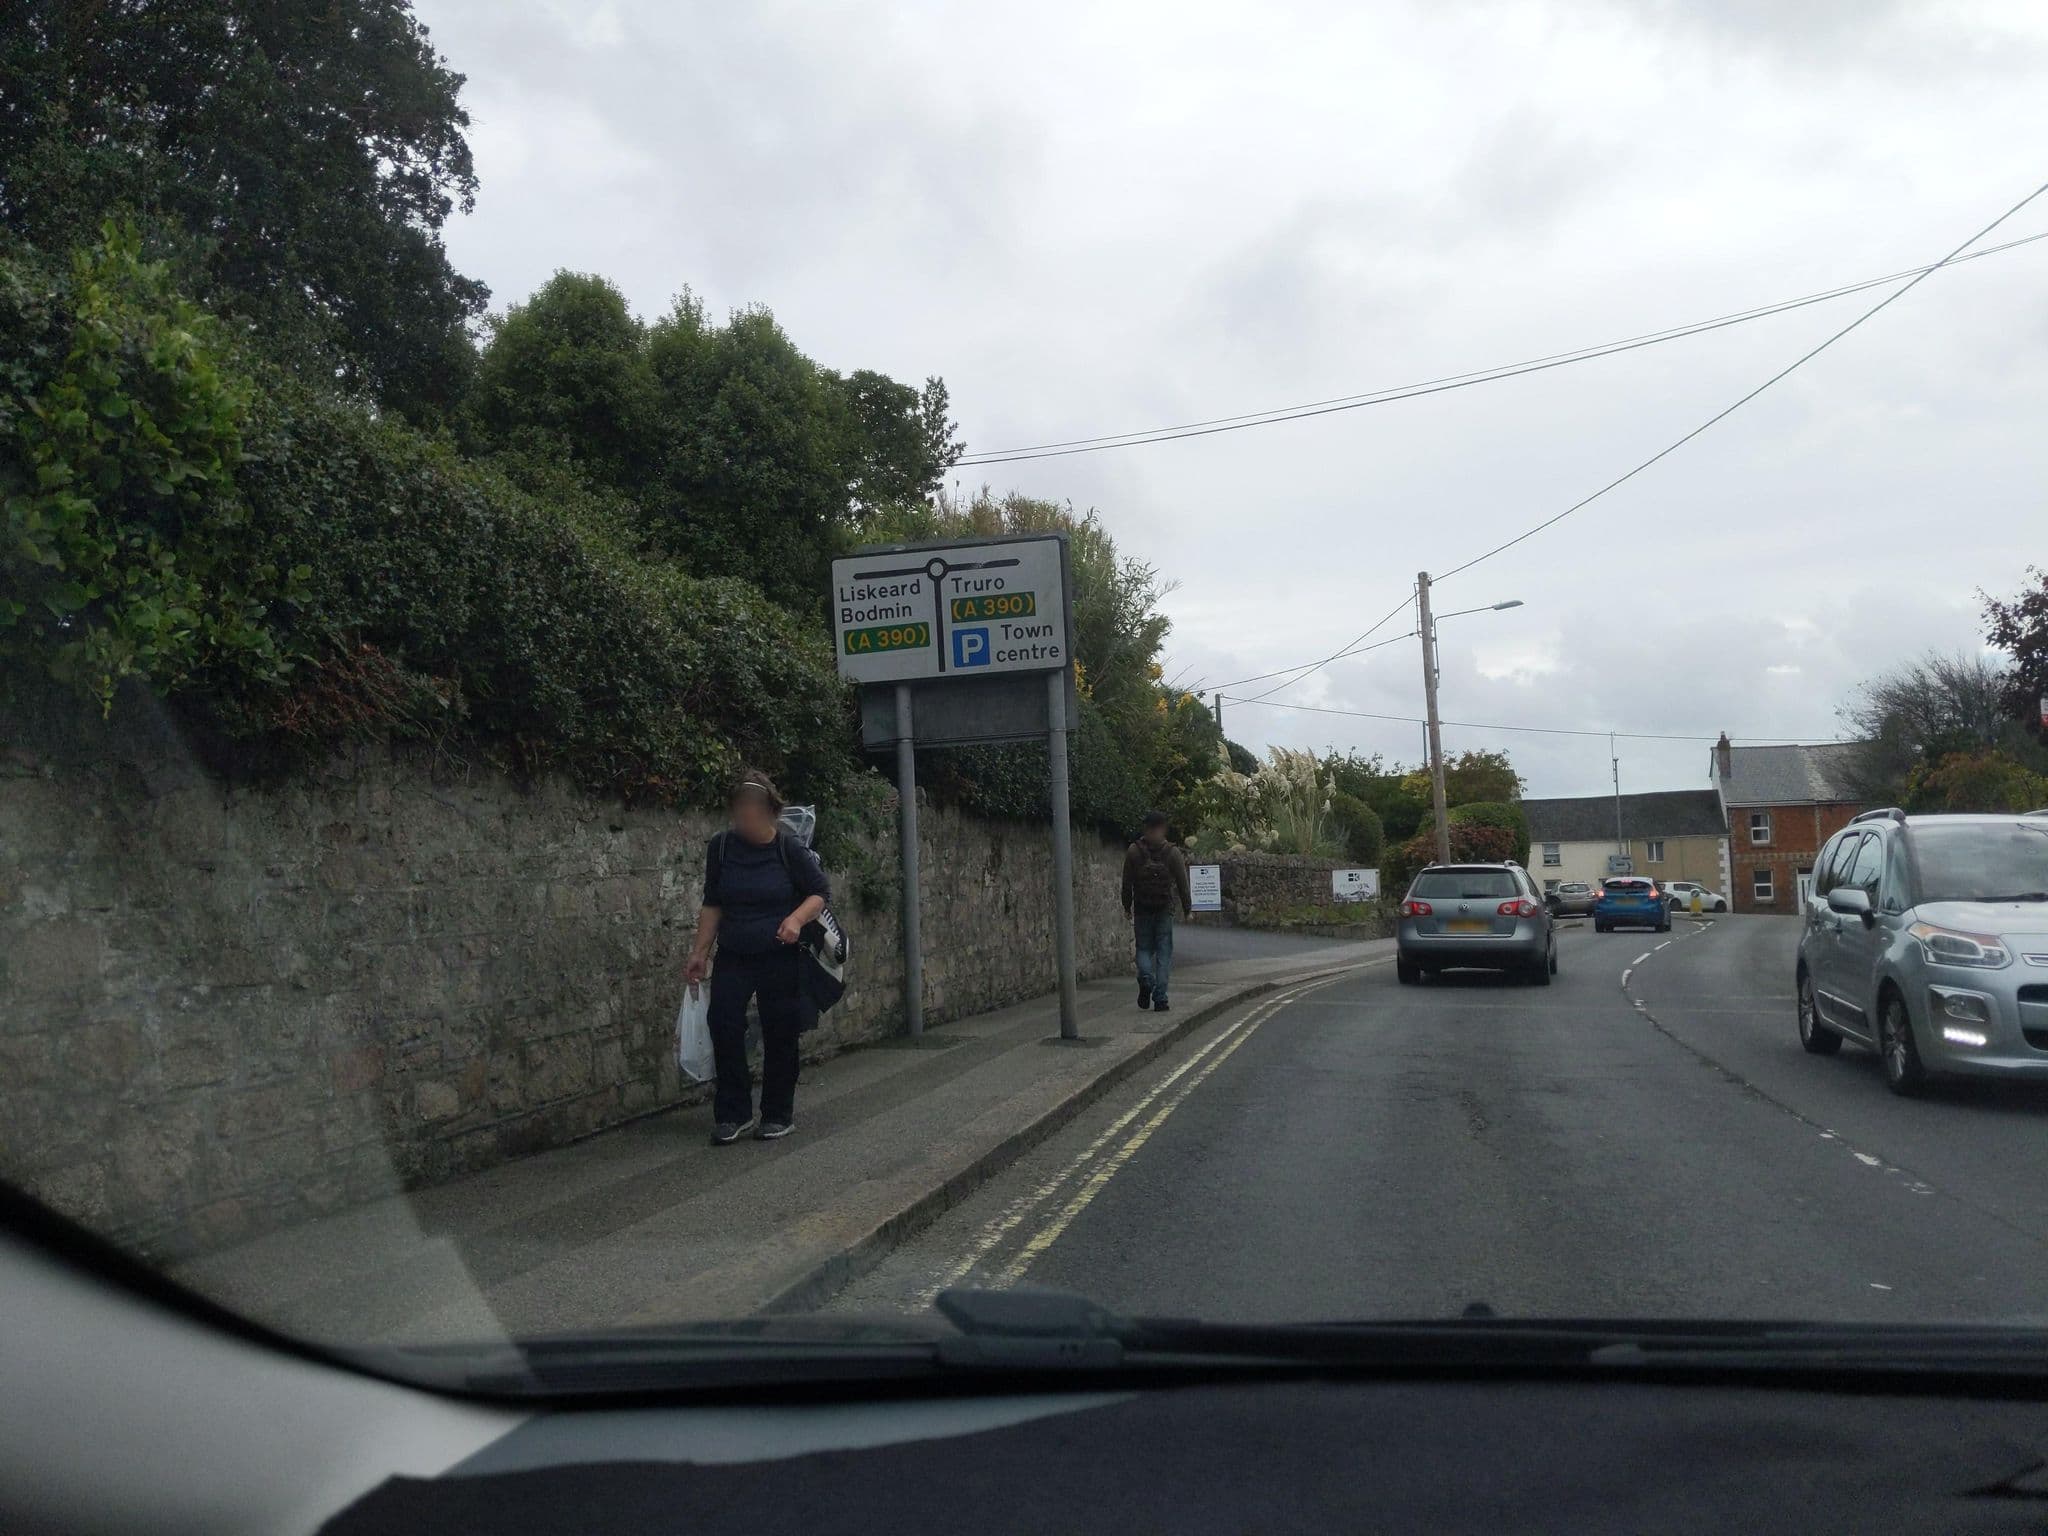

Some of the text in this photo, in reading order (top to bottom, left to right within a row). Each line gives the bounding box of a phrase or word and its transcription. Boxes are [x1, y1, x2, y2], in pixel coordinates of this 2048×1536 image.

[840, 579, 921, 602] Liskeard
[951, 577, 1005, 593] Truro
[841, 602, 912, 623] Bodmin
[1001, 624, 1053, 641] Town
[962, 634, 983, 664] P
[996, 643, 1059, 663] centre
